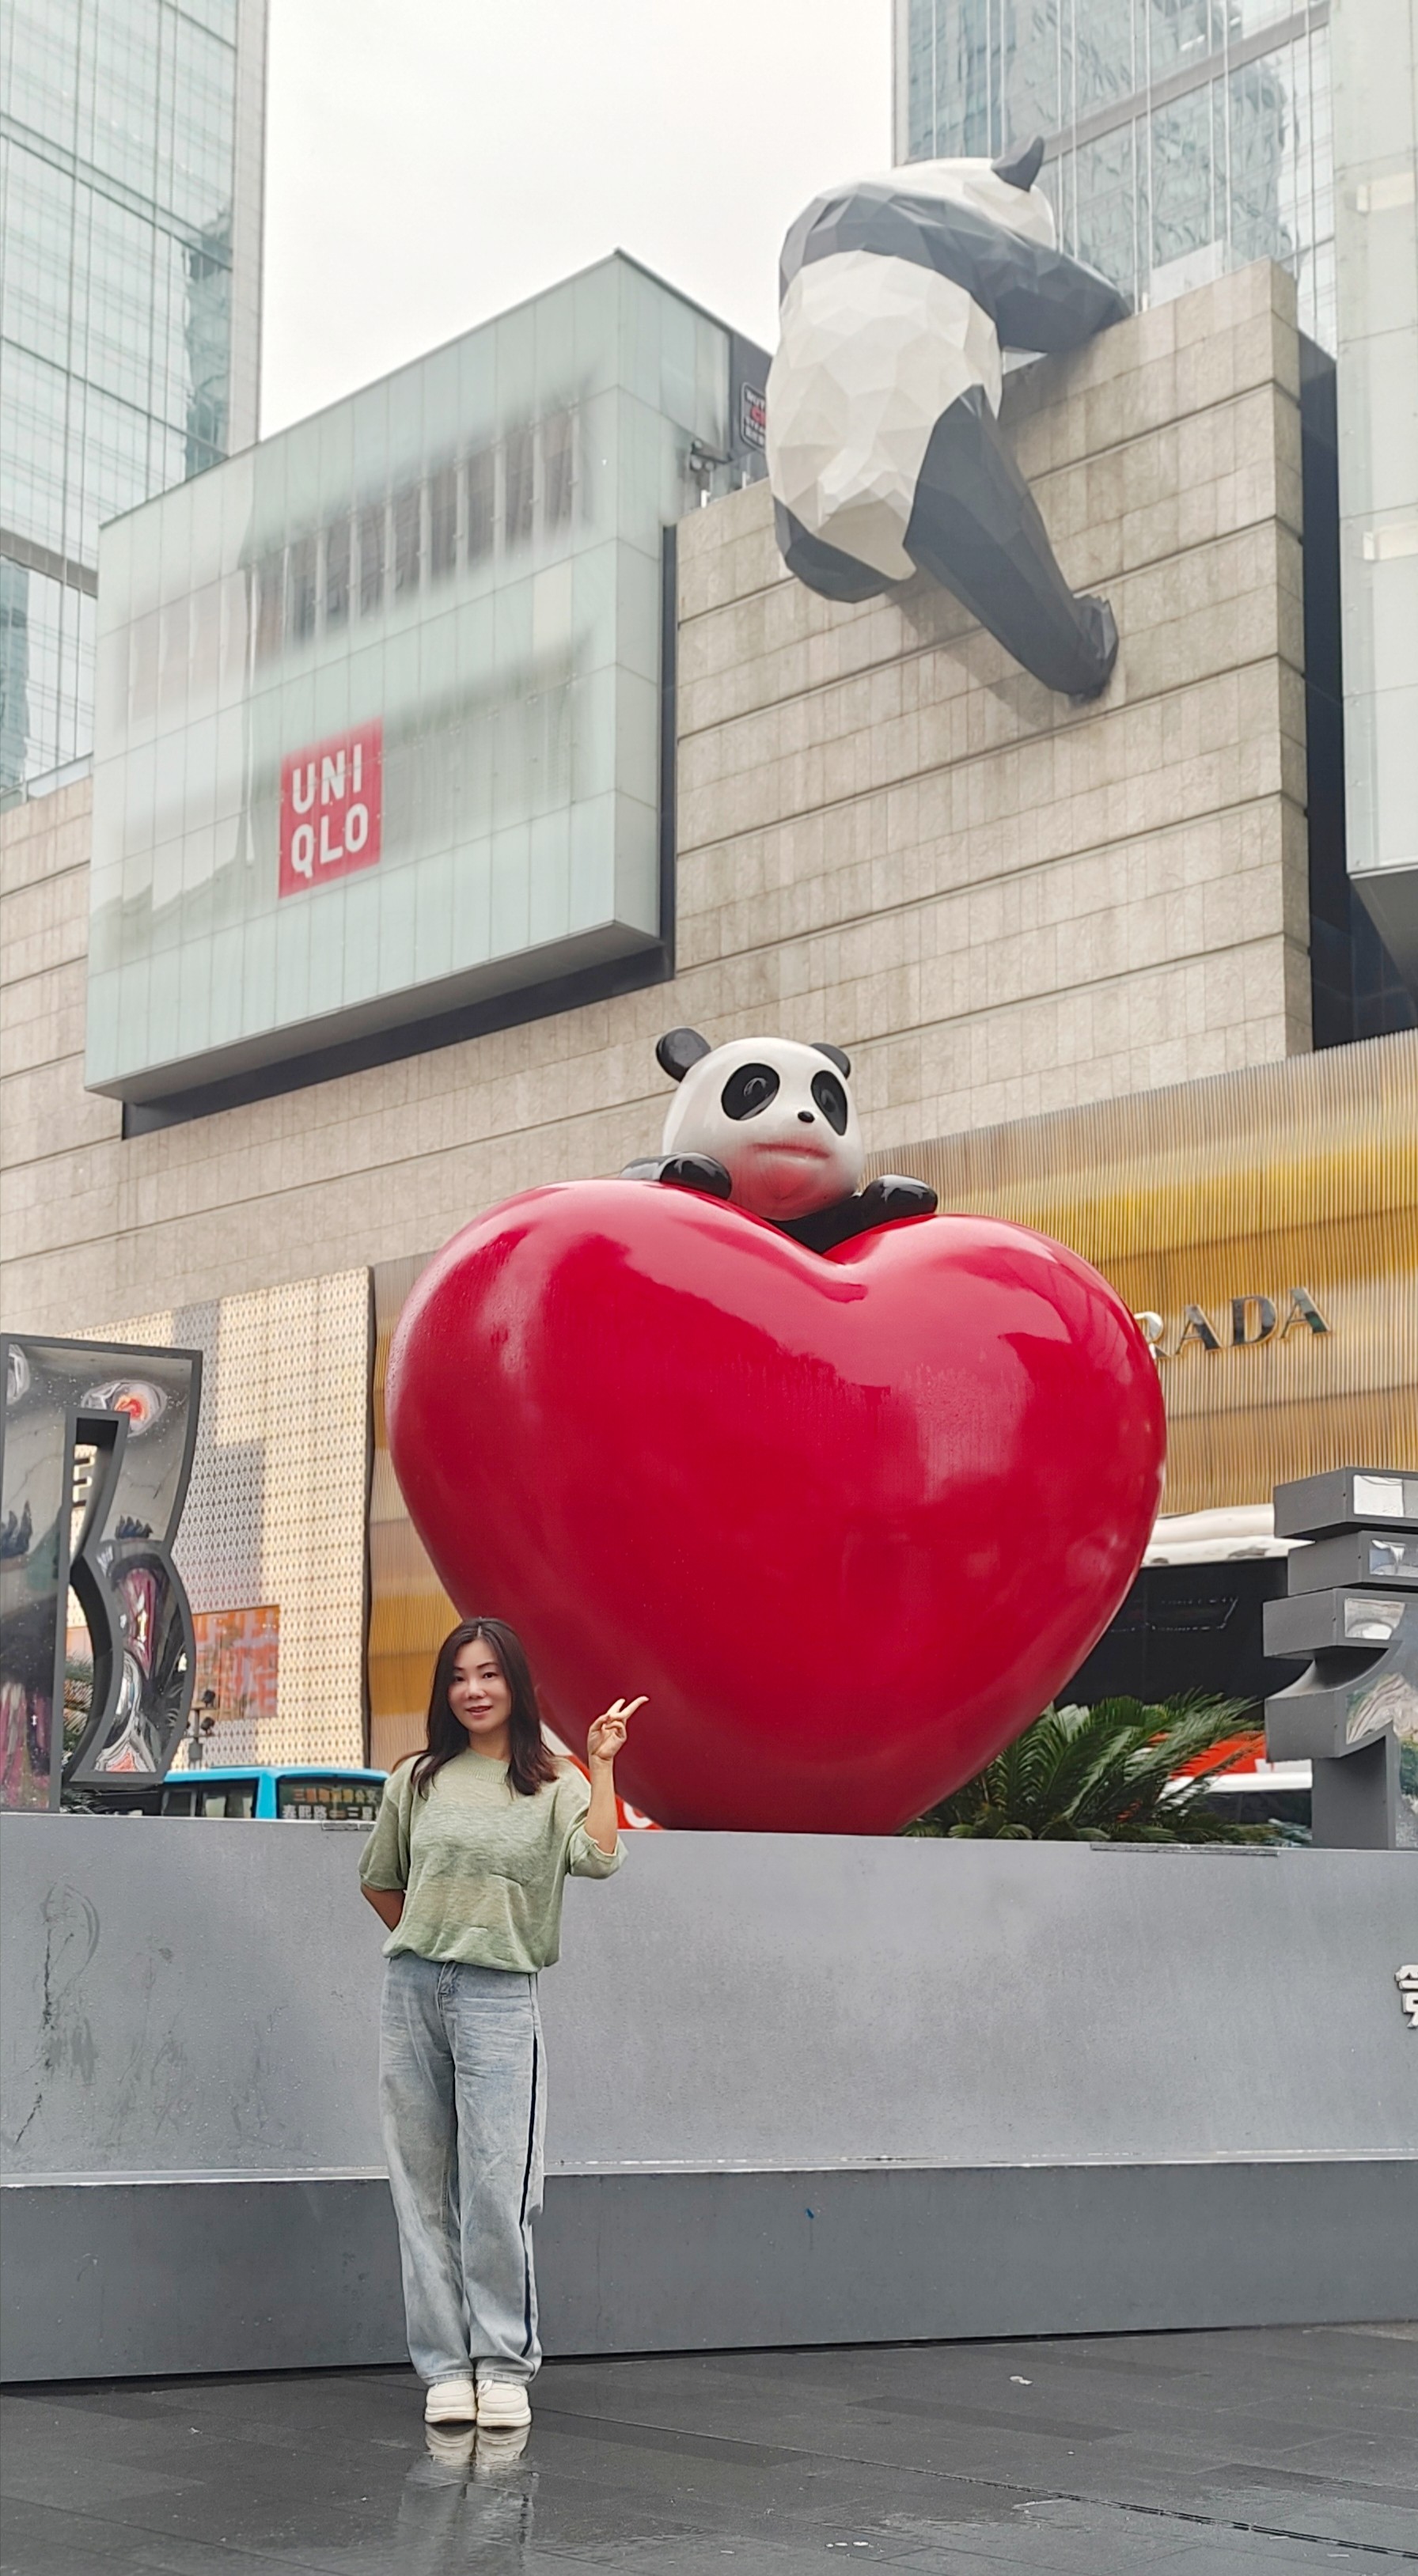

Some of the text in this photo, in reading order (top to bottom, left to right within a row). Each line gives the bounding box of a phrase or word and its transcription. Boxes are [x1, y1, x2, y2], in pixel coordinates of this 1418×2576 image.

[292, 743, 362, 814] UNI
[291, 803, 369, 879] QLO
[347, 1806, 380, 1820] 三星
